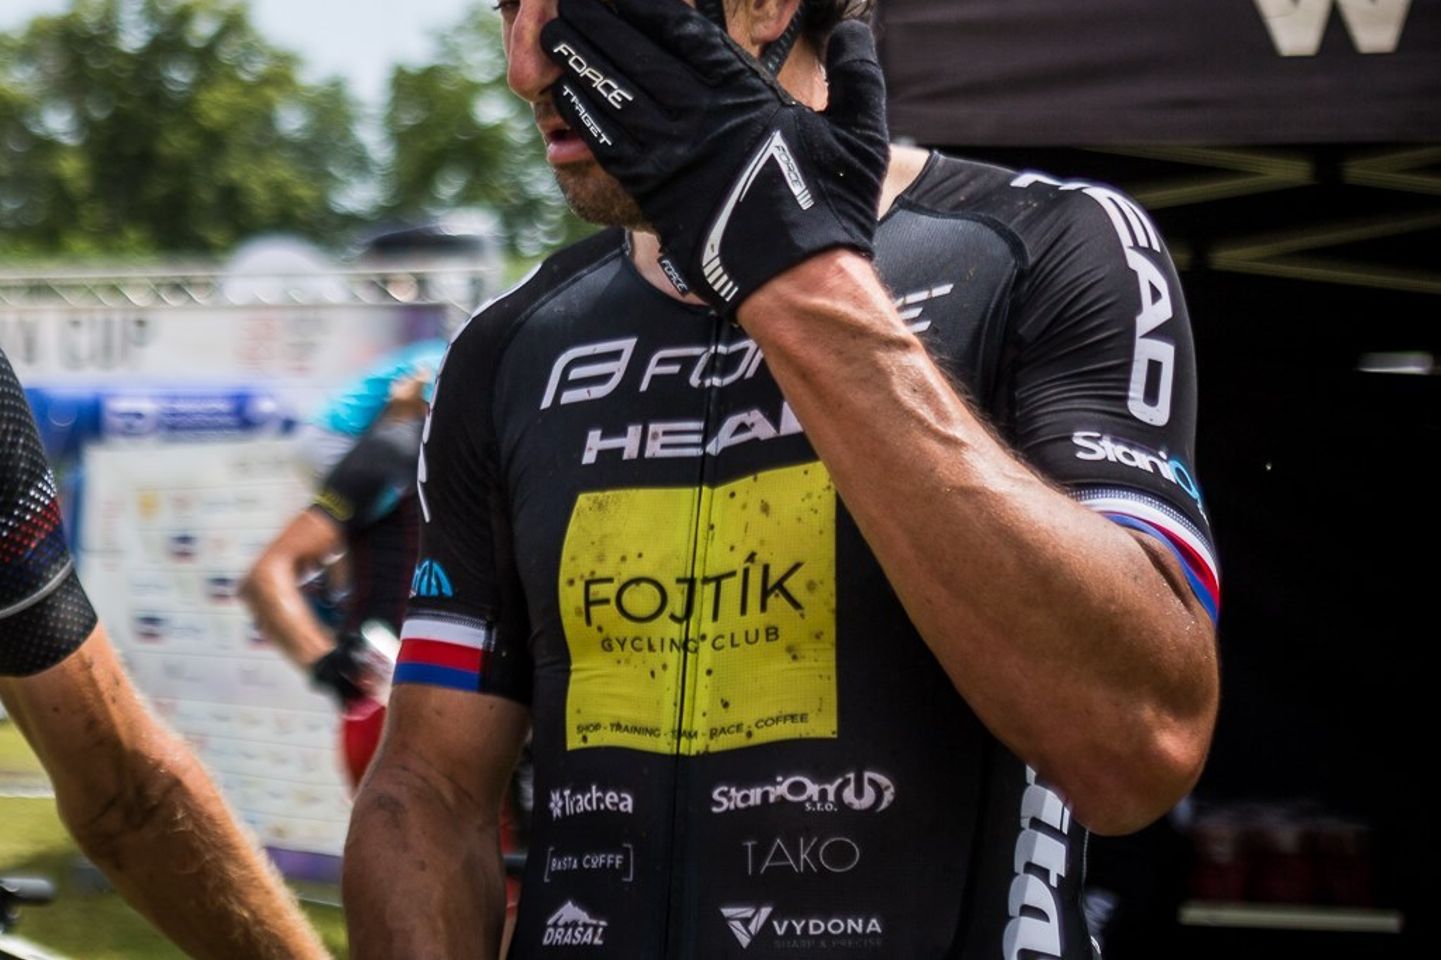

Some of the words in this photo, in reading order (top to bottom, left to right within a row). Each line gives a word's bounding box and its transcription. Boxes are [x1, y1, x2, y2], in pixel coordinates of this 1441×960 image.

[554, 43, 634, 109] FORCE
[1072, 431, 1209, 526] StaniO
[583, 550, 805, 627] FOJTÍK
[601, 636, 698, 654] CYCLING
[711, 626, 780, 650] CLUB
[610, 723, 661, 738] TRAINING
[710, 722, 743, 739] RACE
[755, 713, 809, 729] COFFEE
[742, 837, 860, 876] TAKO
[772, 918, 882, 936] VYDONA
